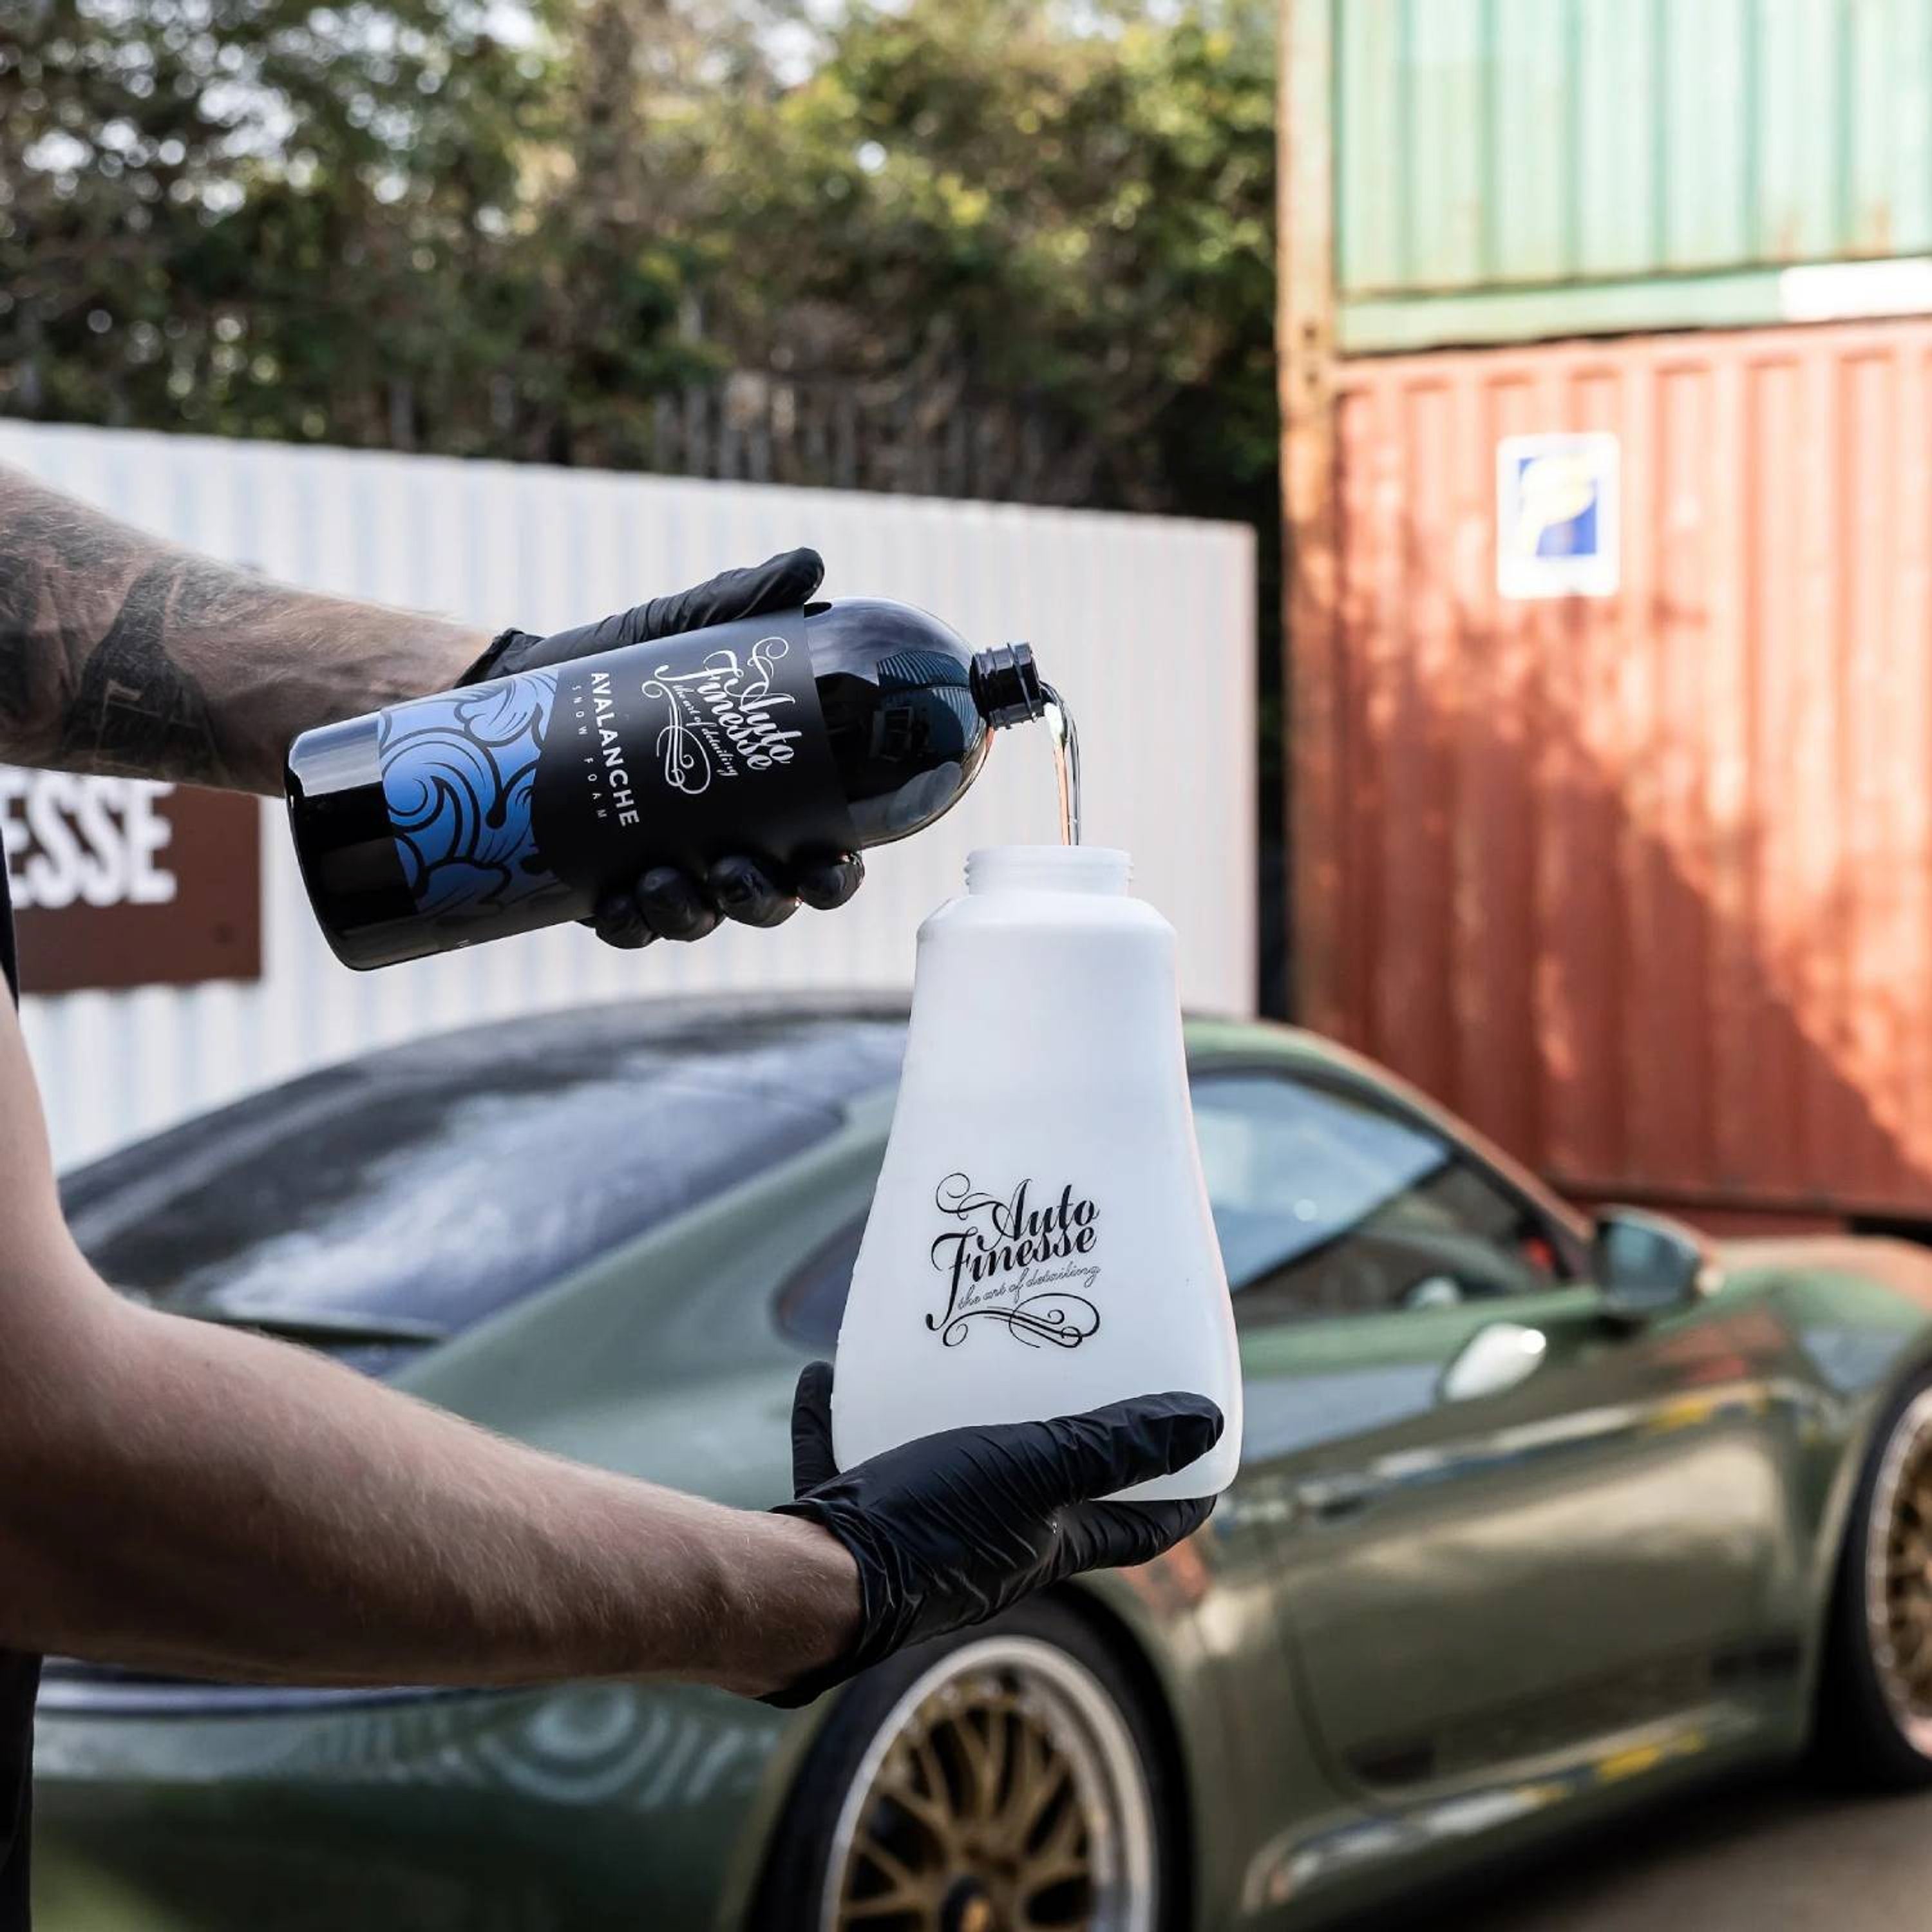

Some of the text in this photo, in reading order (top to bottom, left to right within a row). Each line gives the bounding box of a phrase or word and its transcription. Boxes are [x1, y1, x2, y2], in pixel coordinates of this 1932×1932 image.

[572, 685, 607, 819] SNOW FOAM
[591, 672, 640, 827] AVALANCHE
[654, 650, 773, 770] Finesse
[672, 685, 739, 776] the art of detailing
[724, 636, 802, 764] Auto
[936, 1173, 1100, 1251] Auto
[925, 1226, 1097, 1331] Finesse
[958, 1261, 1101, 1309] the art of detailing
